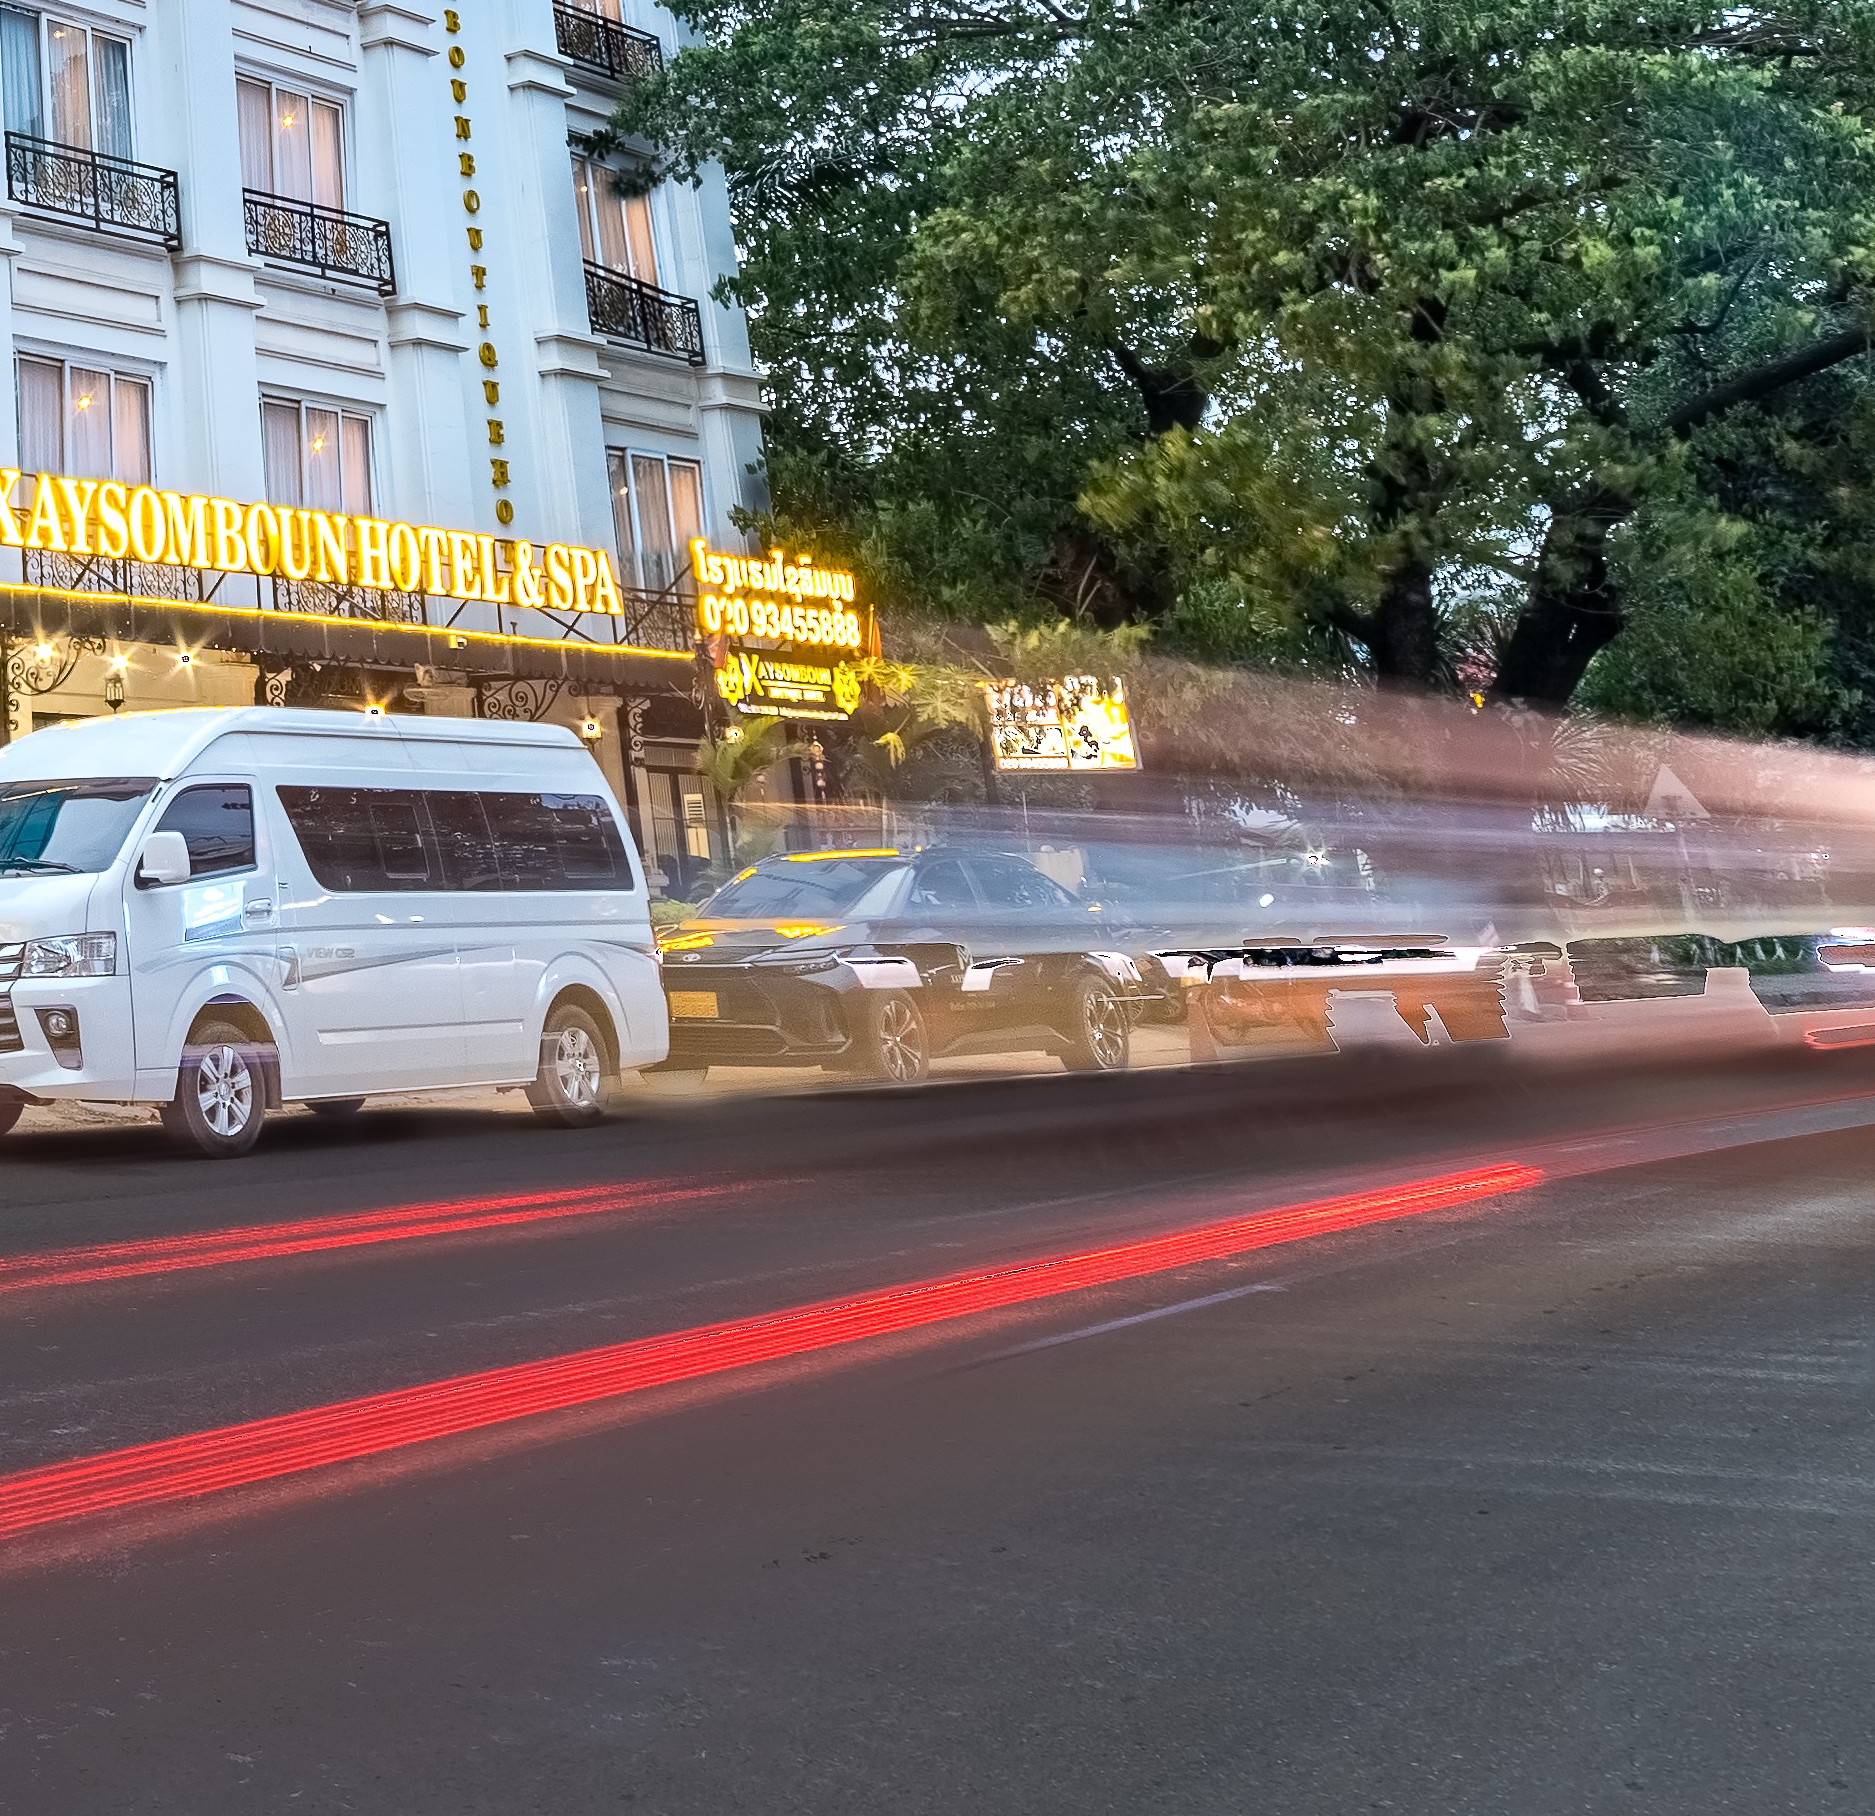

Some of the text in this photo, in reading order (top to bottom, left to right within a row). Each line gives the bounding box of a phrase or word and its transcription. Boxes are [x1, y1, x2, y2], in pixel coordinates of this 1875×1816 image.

[458, 151, 505, 445] BOUTIQUE
[355, 515, 511, 604] HOTEL
[512, 539, 546, 609] &
[545, 542, 623, 616] SPA
[751, 599, 861, 648] 93455888
